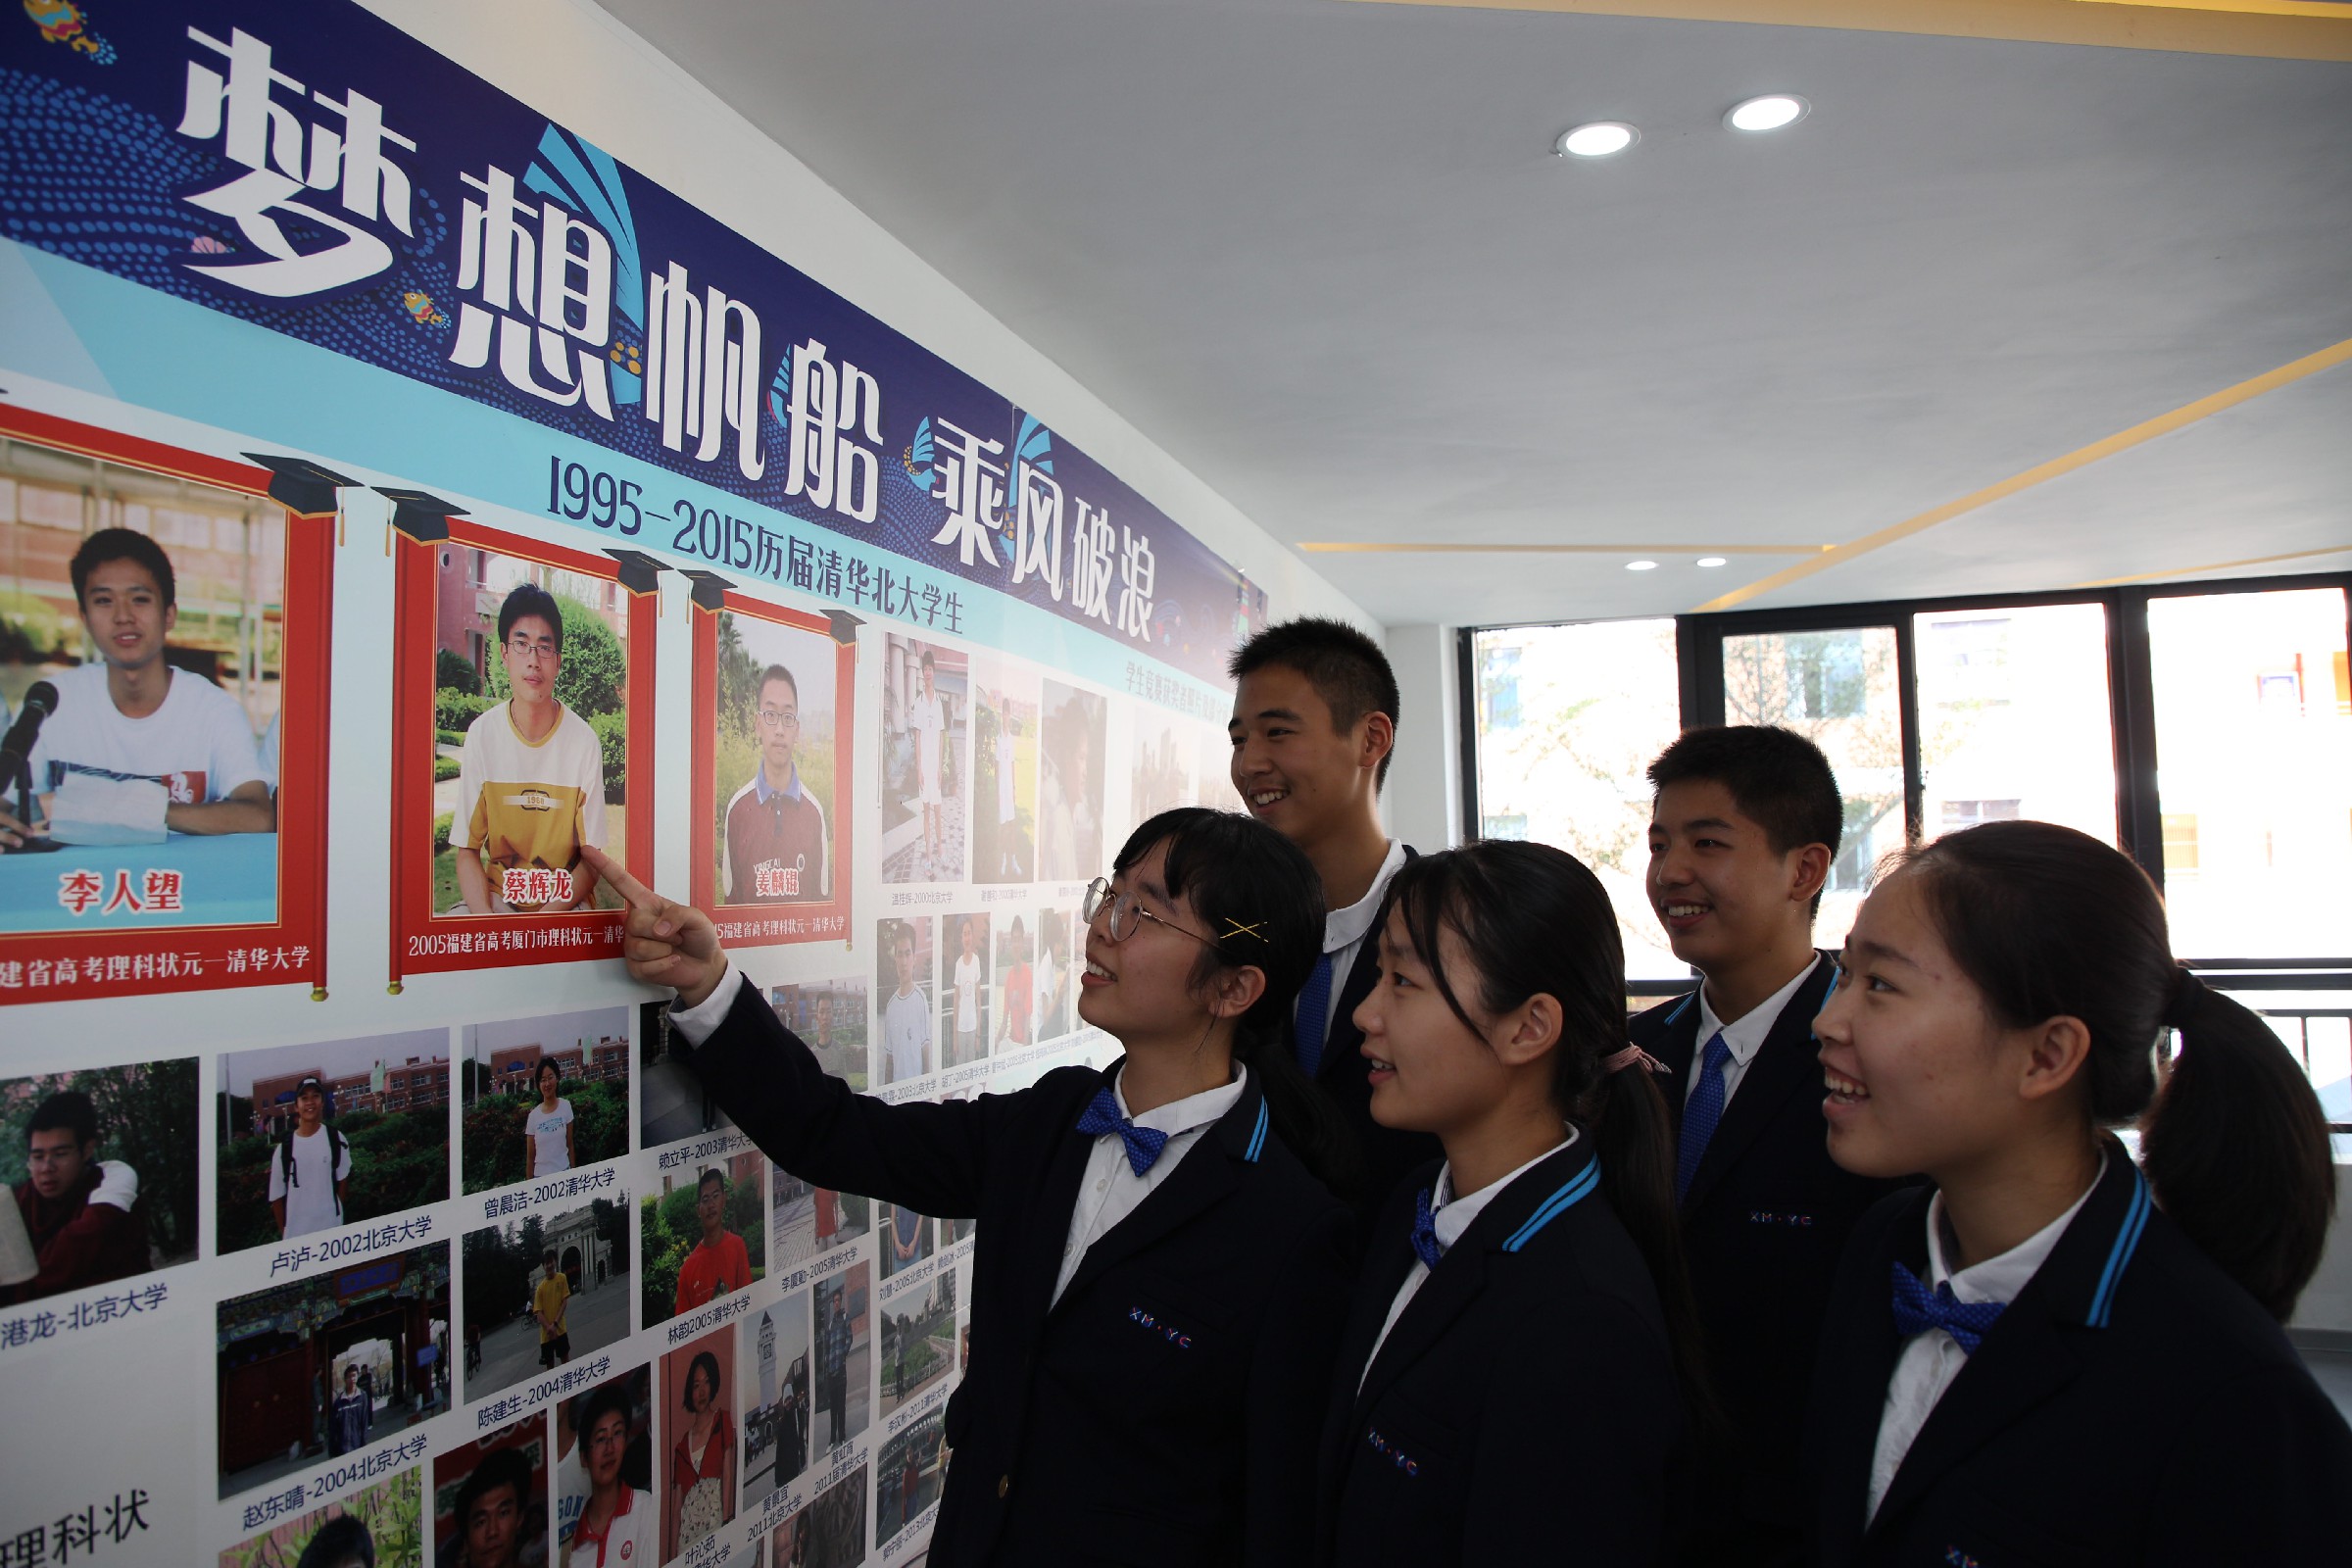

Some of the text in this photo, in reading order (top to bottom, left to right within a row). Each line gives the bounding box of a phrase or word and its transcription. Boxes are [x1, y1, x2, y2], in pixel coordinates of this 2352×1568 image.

[176, 25, 1154, 643] 梦想帆船 乘风破浪
[59, 869, 183, 914] 李人望
[503, 868, 573, 904] 蔡辉龙
[483, 1167, 616, 1220] 曾晨洁-2002清华大学
[0, 1282, 168, 1349] 港龙-北京大学
[477, 1355, 611, 1430] 陈建生-2004清华大学
[242, 1433, 428, 1532] 赵东晴-2004北京大学
[814, 1446, 868, 1495] 2011届清华大学
[0, 1489, 149, 1568] 理科状
[747, 1493, 803, 1543] 2011北京大学
